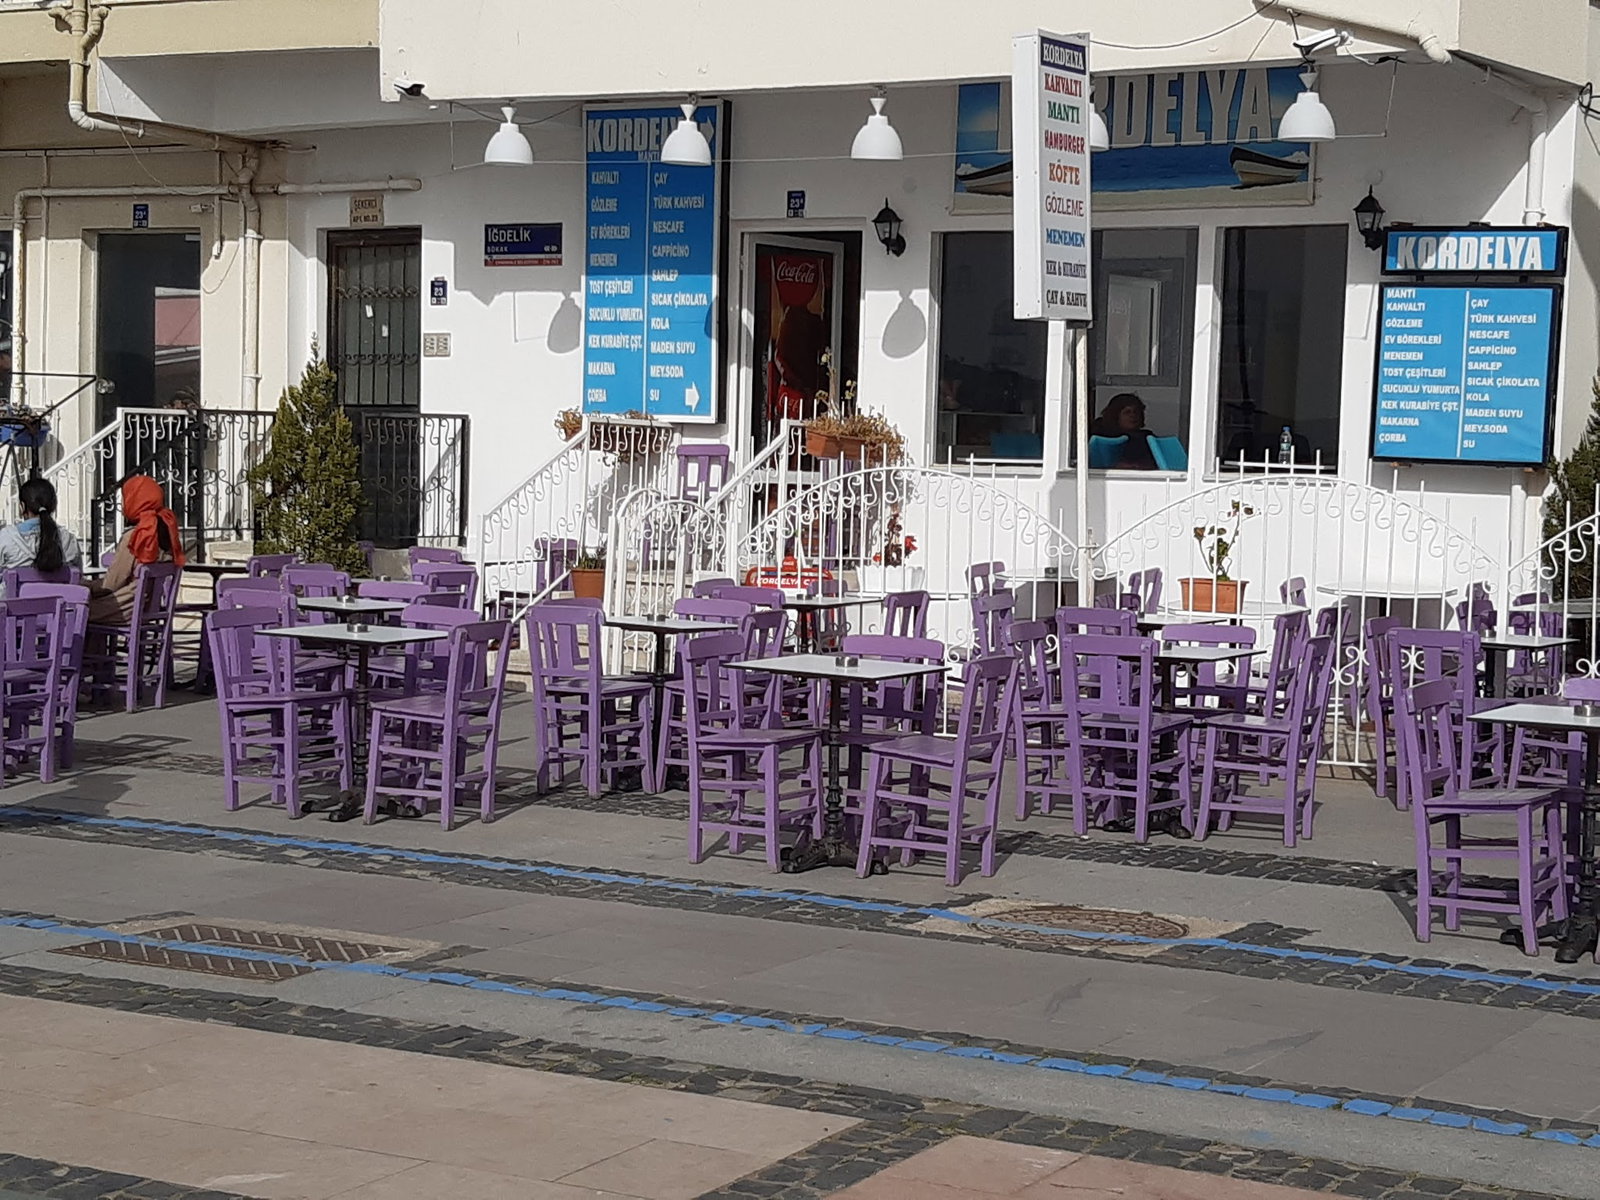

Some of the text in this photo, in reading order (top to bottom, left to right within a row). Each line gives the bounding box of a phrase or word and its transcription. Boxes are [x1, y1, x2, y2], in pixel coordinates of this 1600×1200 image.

[1043, 43, 1084, 70] KORDELYA
[1044, 73, 1082, 97] KAHVALTI
[998, 68, 1271, 153] DELYA
[1048, 101, 1080, 124] MANTI
[588, 116, 684, 152] KORDEL
[1044, 129, 1085, 155] HAMBURGER
[591, 171, 619, 184] KAHVALTI
[1049, 160, 1080, 185] KÖFTE
[654, 173, 668, 187] ÇAY
[591, 196, 617, 212] GÖZLEME
[653, 194, 705, 209] TÜRK KAHVESİ
[1045, 192, 1084, 217] GÖZLEME
[590, 223, 630, 239] EV BÖREKLERİ
[652, 221, 684, 233] NESCAFE
[1045, 228, 1085, 247] MENEMEN
[652, 243, 689, 257] CAPPİCİNO
[1397, 236, 1542, 270] KORDELYA
[652, 269, 678, 282] SAHLEP
[590, 279, 633, 297] TOST ÇEŞİTLERİ
[1387, 289, 1416, 299] MANTI
[651, 291, 707, 308] SICAK ÇİKOLATA
[1046, 289, 1058, 308] ÇAY
[1060, 290, 1065, 305] &
[1471, 299, 1489, 309] ÇAY
[1386, 302, 1425, 311] KAHVALTI
[589, 308, 643, 322] SUCUKLU YUMURTA
[1470, 313, 1537, 323] TÜRK KAHVESİ
[651, 317, 670, 330] KOLA
[1385, 317, 1423, 328] GÖZLEME
[589, 335, 601, 348] KEK
[601, 333, 629, 348] KURABİYE
[1384, 334, 1442, 345] EV BÖREKLERİ
[1469, 330, 1510, 339] NESCAFE
[650, 341, 696, 354] MADEN SUYU
[1468, 345, 1517, 355] CAPPİCİNO
[1384, 351, 1423, 361] MENEMEN
[588, 361, 615, 375] MAKARNA
[1383, 367, 1446, 379] TOST ÇEŞİTLERİ
[1467, 362, 1502, 371] SAHLEP
[1467, 376, 1540, 388] SICAK ÇİKOLATA
[649, 389, 660, 401] SU
[1382, 384, 1460, 394] SUCUKLU YUMURTA
[587, 389, 607, 404] ÇORBA
[1466, 393, 1490, 402] KOLA
[1381, 401, 1397, 410] KEK
[1399, 400, 1440, 410] KURABİYE
[1465, 409, 1524, 418] MADEN SUYU
[1380, 417, 1419, 426] MAKARNA
[1464, 424, 1508, 434] MEY.SODA
[1379, 433, 1406, 443] ÇORBA
[1463, 440, 1476, 448] SU
